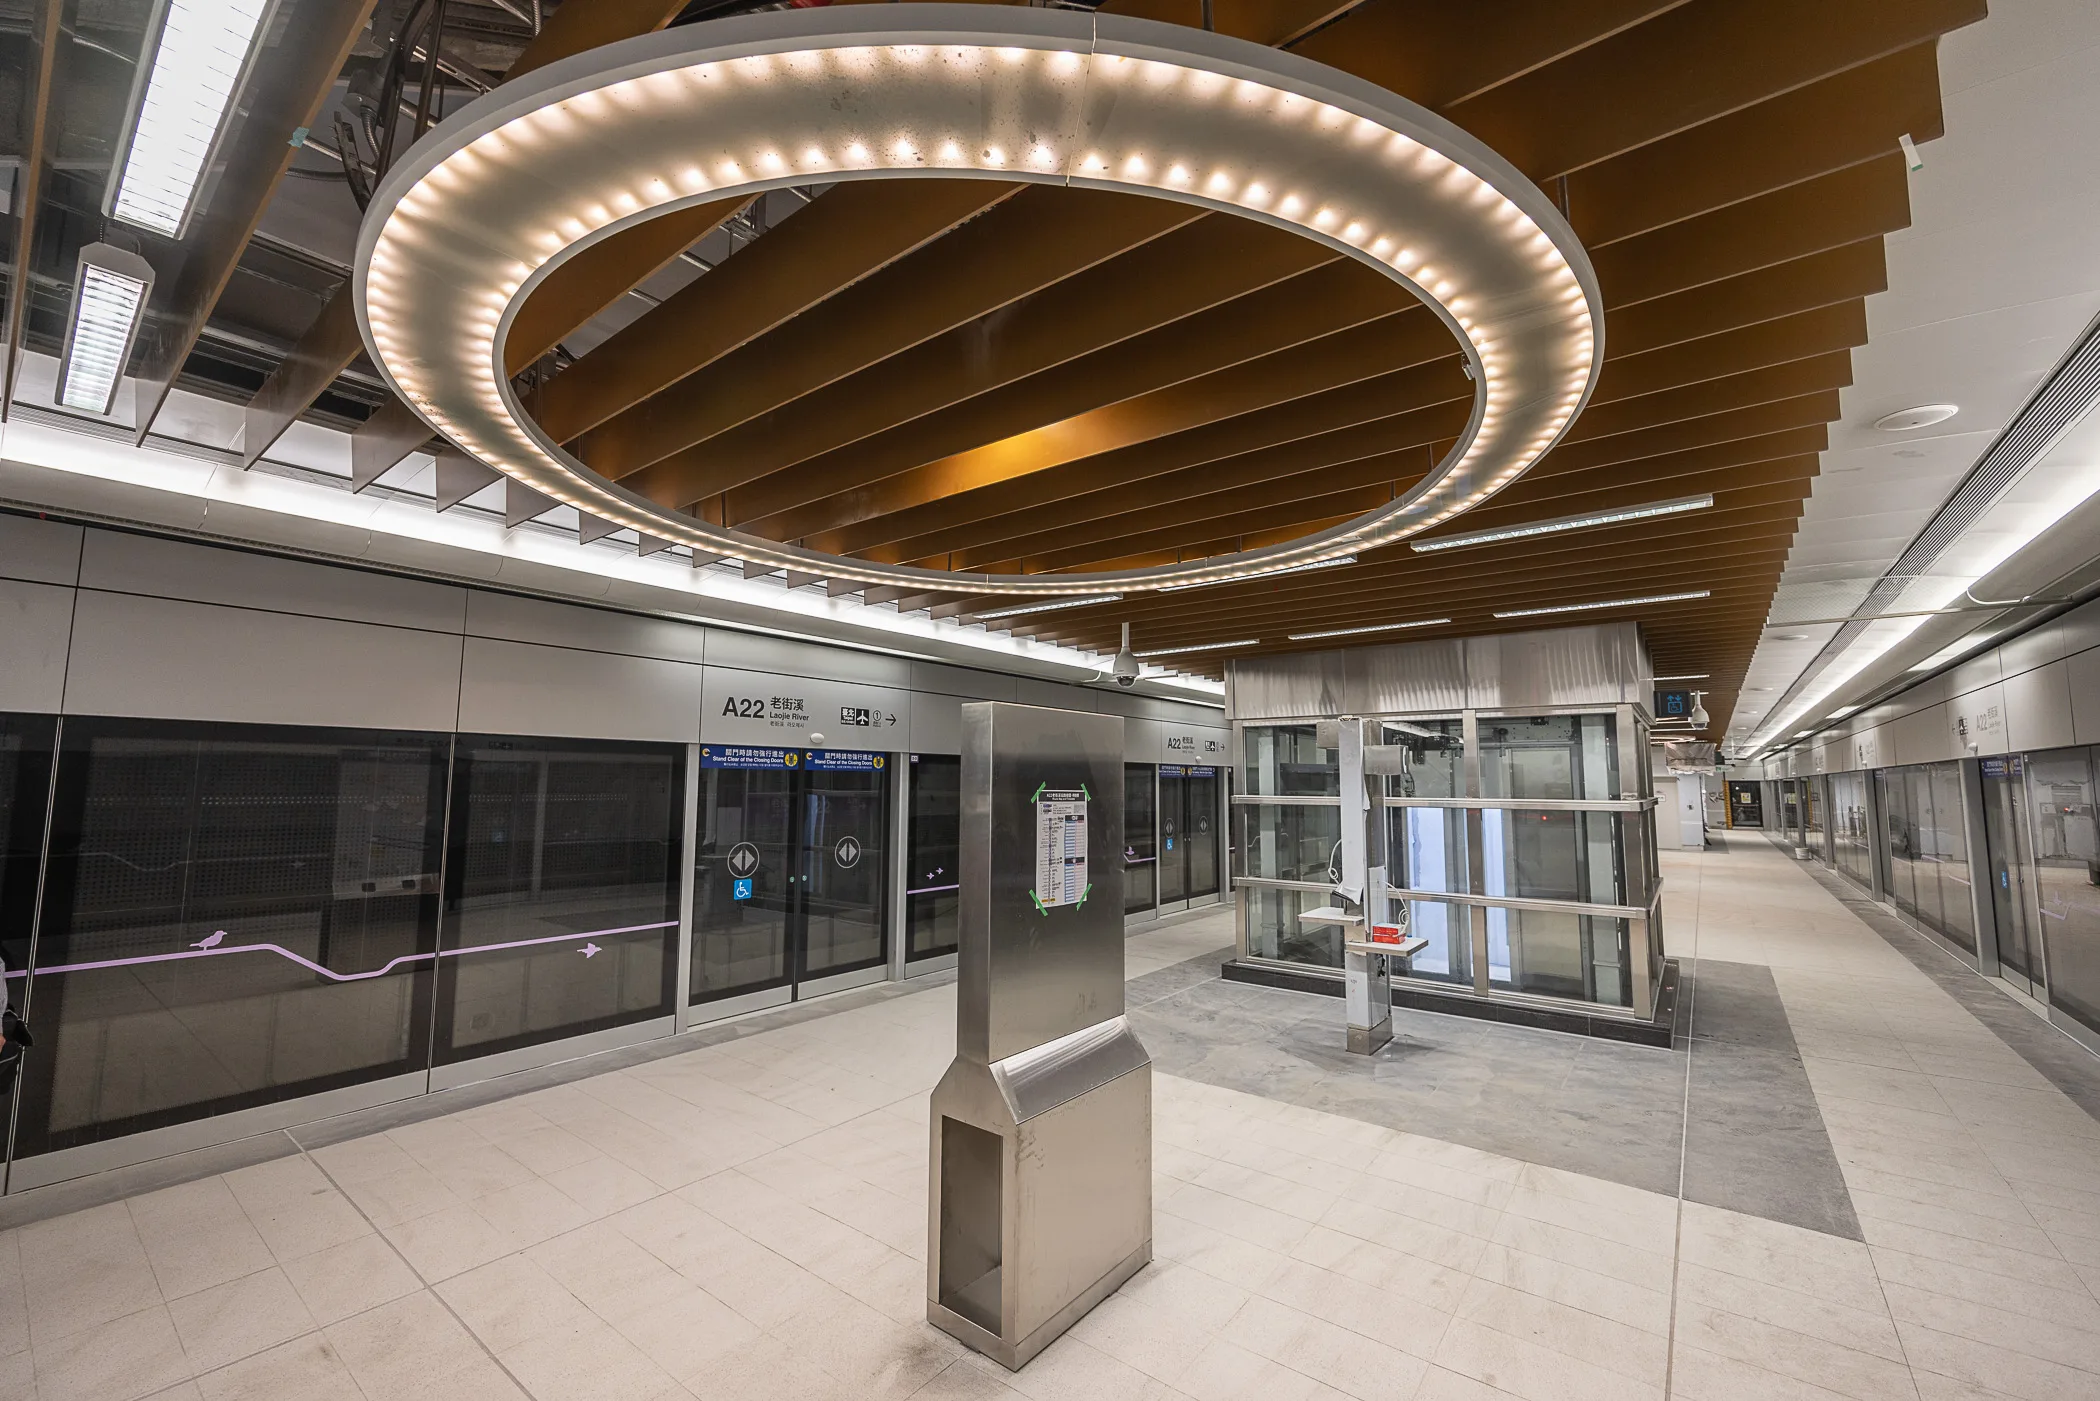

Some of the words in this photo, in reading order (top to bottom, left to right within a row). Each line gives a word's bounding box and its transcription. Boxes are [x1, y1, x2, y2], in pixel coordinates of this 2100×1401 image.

[722, 696, 765, 719] A22
[770, 696, 804, 712] 老街溪
[769, 712, 790, 720] Laojie
[792, 713, 810, 721] River
[1168, 738, 1181, 749] A22
